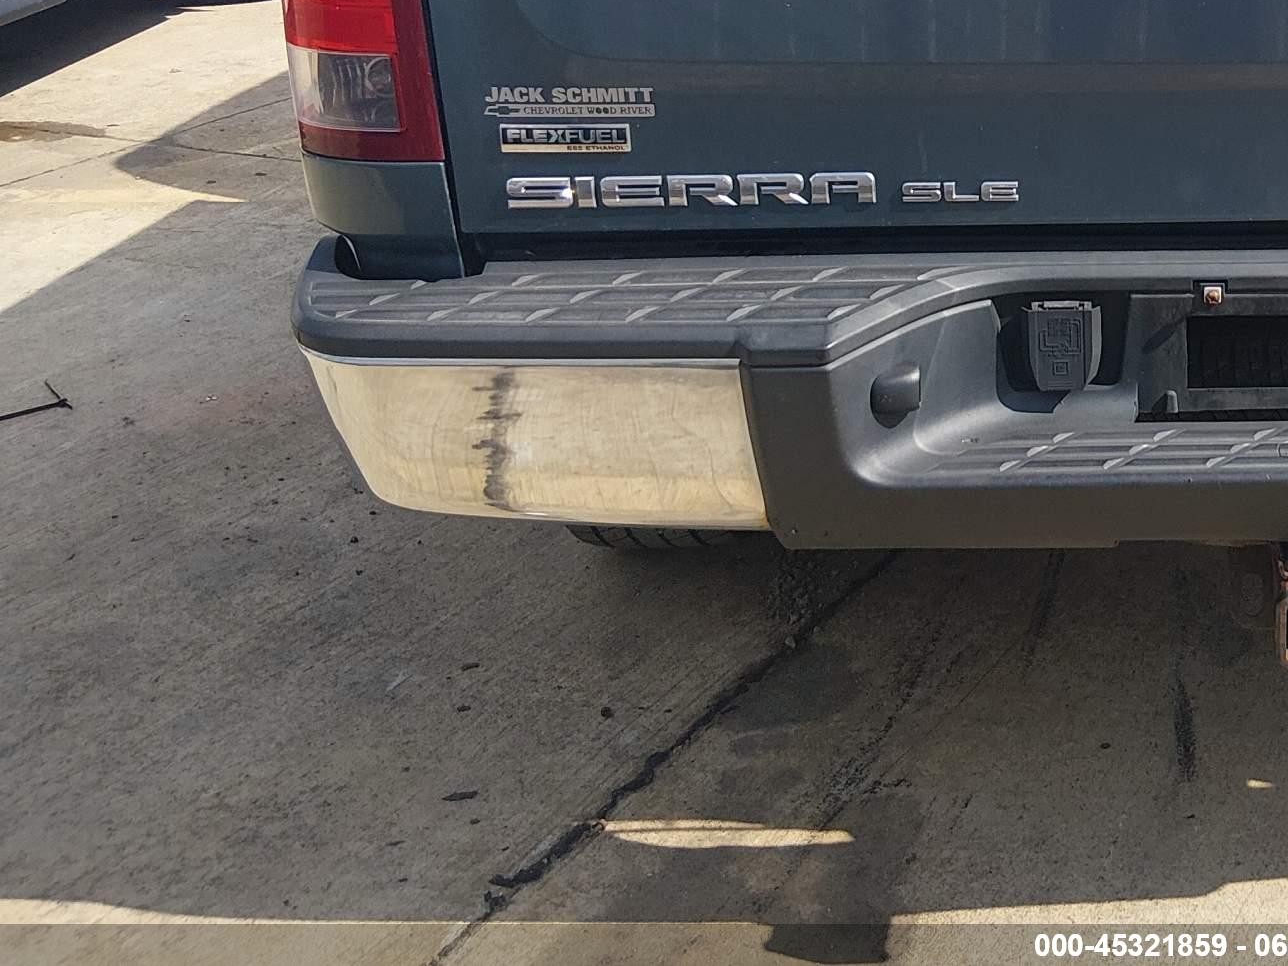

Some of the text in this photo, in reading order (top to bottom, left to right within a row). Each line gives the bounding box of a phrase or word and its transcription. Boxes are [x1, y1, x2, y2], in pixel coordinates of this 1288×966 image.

[485, 87, 654, 104] JACK SCHMITT
[523, 106, 652, 115] CHEVROLET WOOD RIVER
[506, 128, 626, 144] FLEXFUEL
[506, 171, 877, 209] SIERRA
[902, 180, 1020, 203] SLE
